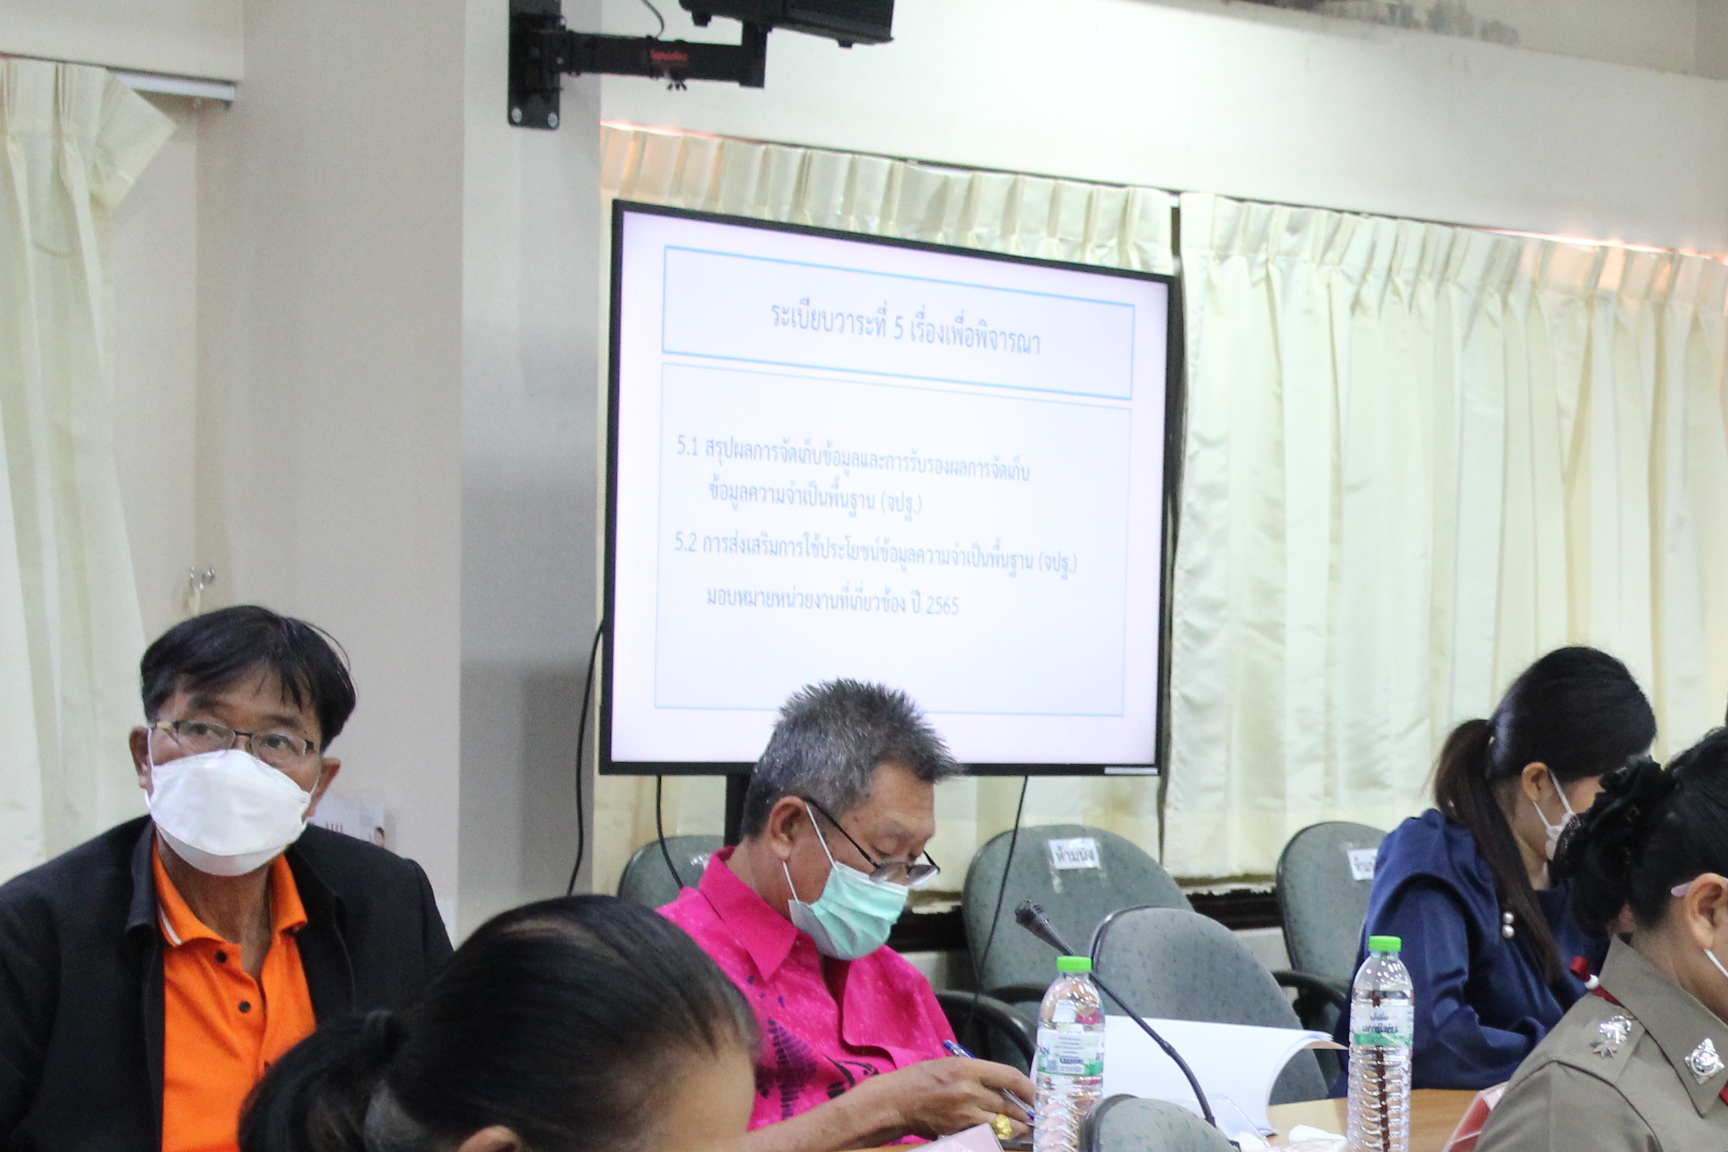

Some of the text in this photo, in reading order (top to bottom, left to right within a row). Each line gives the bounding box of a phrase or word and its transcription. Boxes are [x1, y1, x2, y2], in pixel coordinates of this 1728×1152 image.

[771, 297, 1041, 355] ระเบียบวาระที่ 5 เรื่องเพื่อพิจารณา
[676, 434, 698, 457] 5.1
[674, 531, 697, 553] 5.2
[926, 595, 960, 616] 2565
